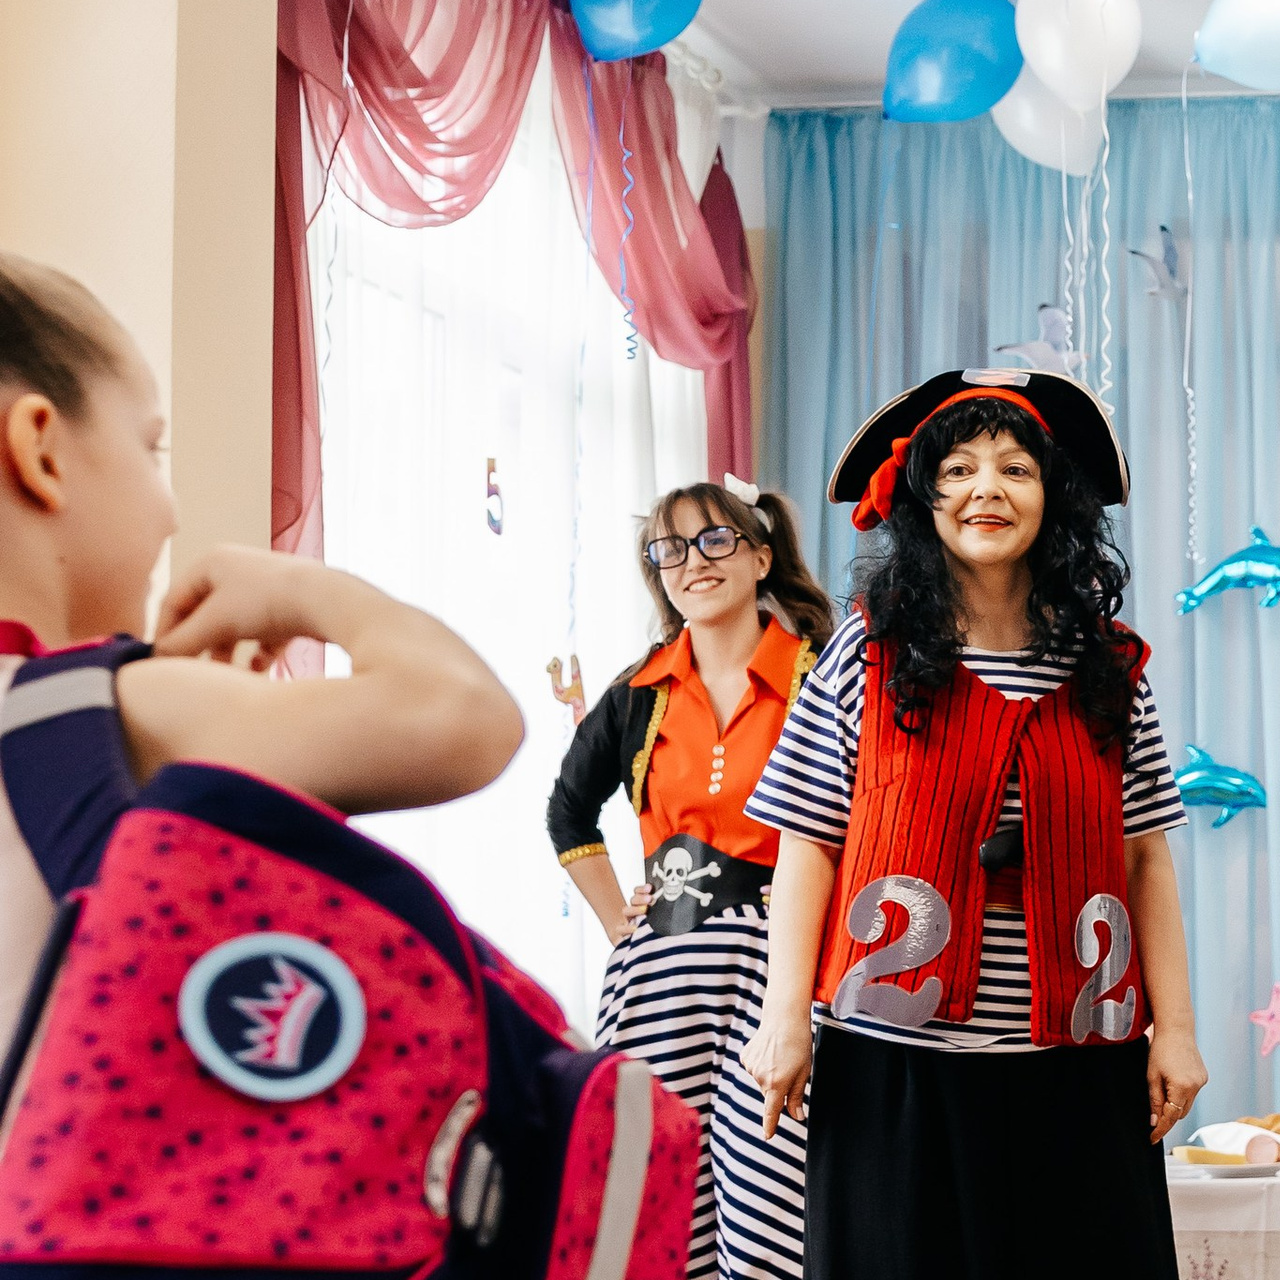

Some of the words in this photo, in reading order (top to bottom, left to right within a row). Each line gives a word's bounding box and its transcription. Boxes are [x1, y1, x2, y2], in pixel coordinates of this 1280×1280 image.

[487, 458, 503, 535] 5
[831, 875, 951, 1027] 2
[1071, 893, 1136, 1044] 2
